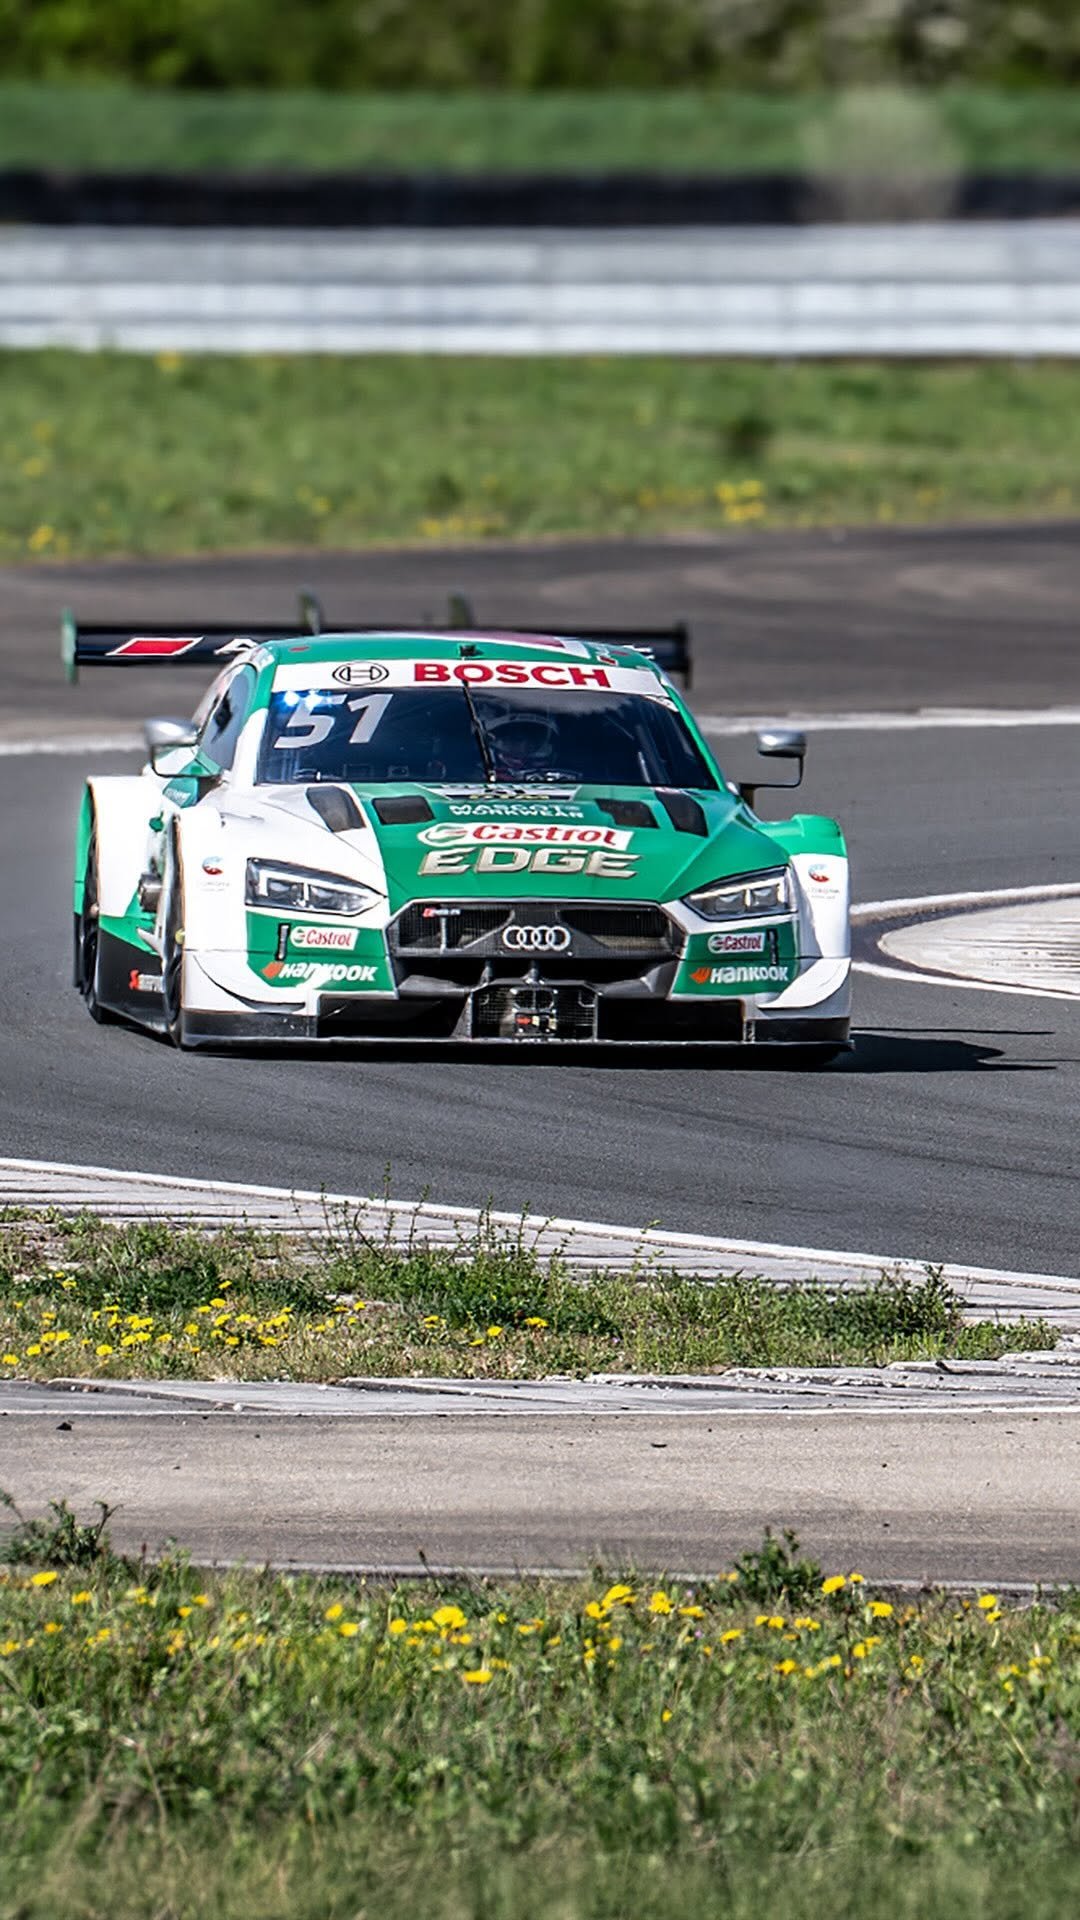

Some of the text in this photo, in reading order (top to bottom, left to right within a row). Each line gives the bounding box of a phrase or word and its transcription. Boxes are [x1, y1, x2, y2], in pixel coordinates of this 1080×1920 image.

[414, 663, 612, 688] BOSCH
[274, 693, 394, 749] 51
[471, 825, 616, 846] Castrol
[418, 847, 643, 879] EDGE
[306, 929, 351, 946] Castrol
[723, 934, 762, 950] Castrol
